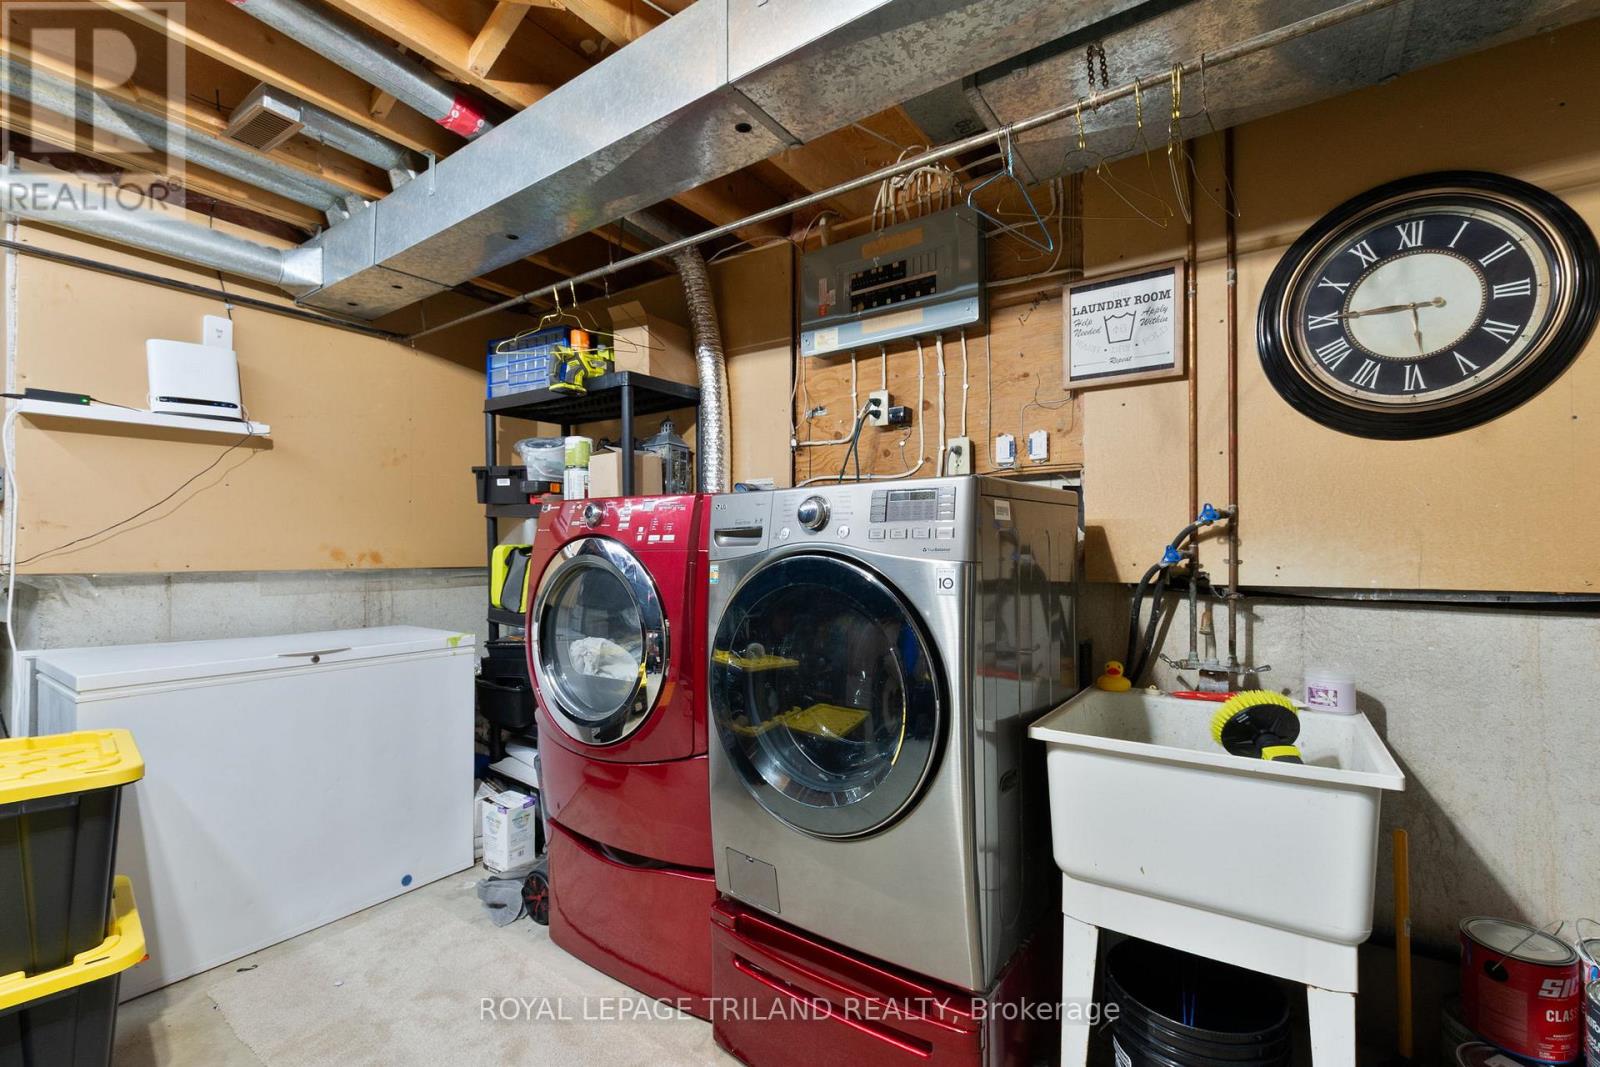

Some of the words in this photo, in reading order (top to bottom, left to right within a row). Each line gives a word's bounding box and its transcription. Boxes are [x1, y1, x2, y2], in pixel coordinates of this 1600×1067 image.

[1395, 219, 1426, 250] XII
[1448, 220, 1471, 249] I
[1347, 239, 1380, 269] XI
[1478, 240, 1516, 268] II
[1317, 276, 1350, 295] X
[1493, 277, 1531, 300] III
[1072, 297, 1131, 316] LAUNDRY
[1134, 289, 1172, 305] ROOM
[1141, 304, 1168, 317] Apply
[1073, 317, 1093, 328] Help
[1073, 325, 1102, 338] Needed
[1139, 316, 1168, 327] Within
[1481, 318, 1521, 344] IV
[1315, 336, 1353, 371] VIII
[1452, 350, 1480, 376] V
[1349, 359, 1382, 389] VII
[1403, 364, 1427, 391] VI
